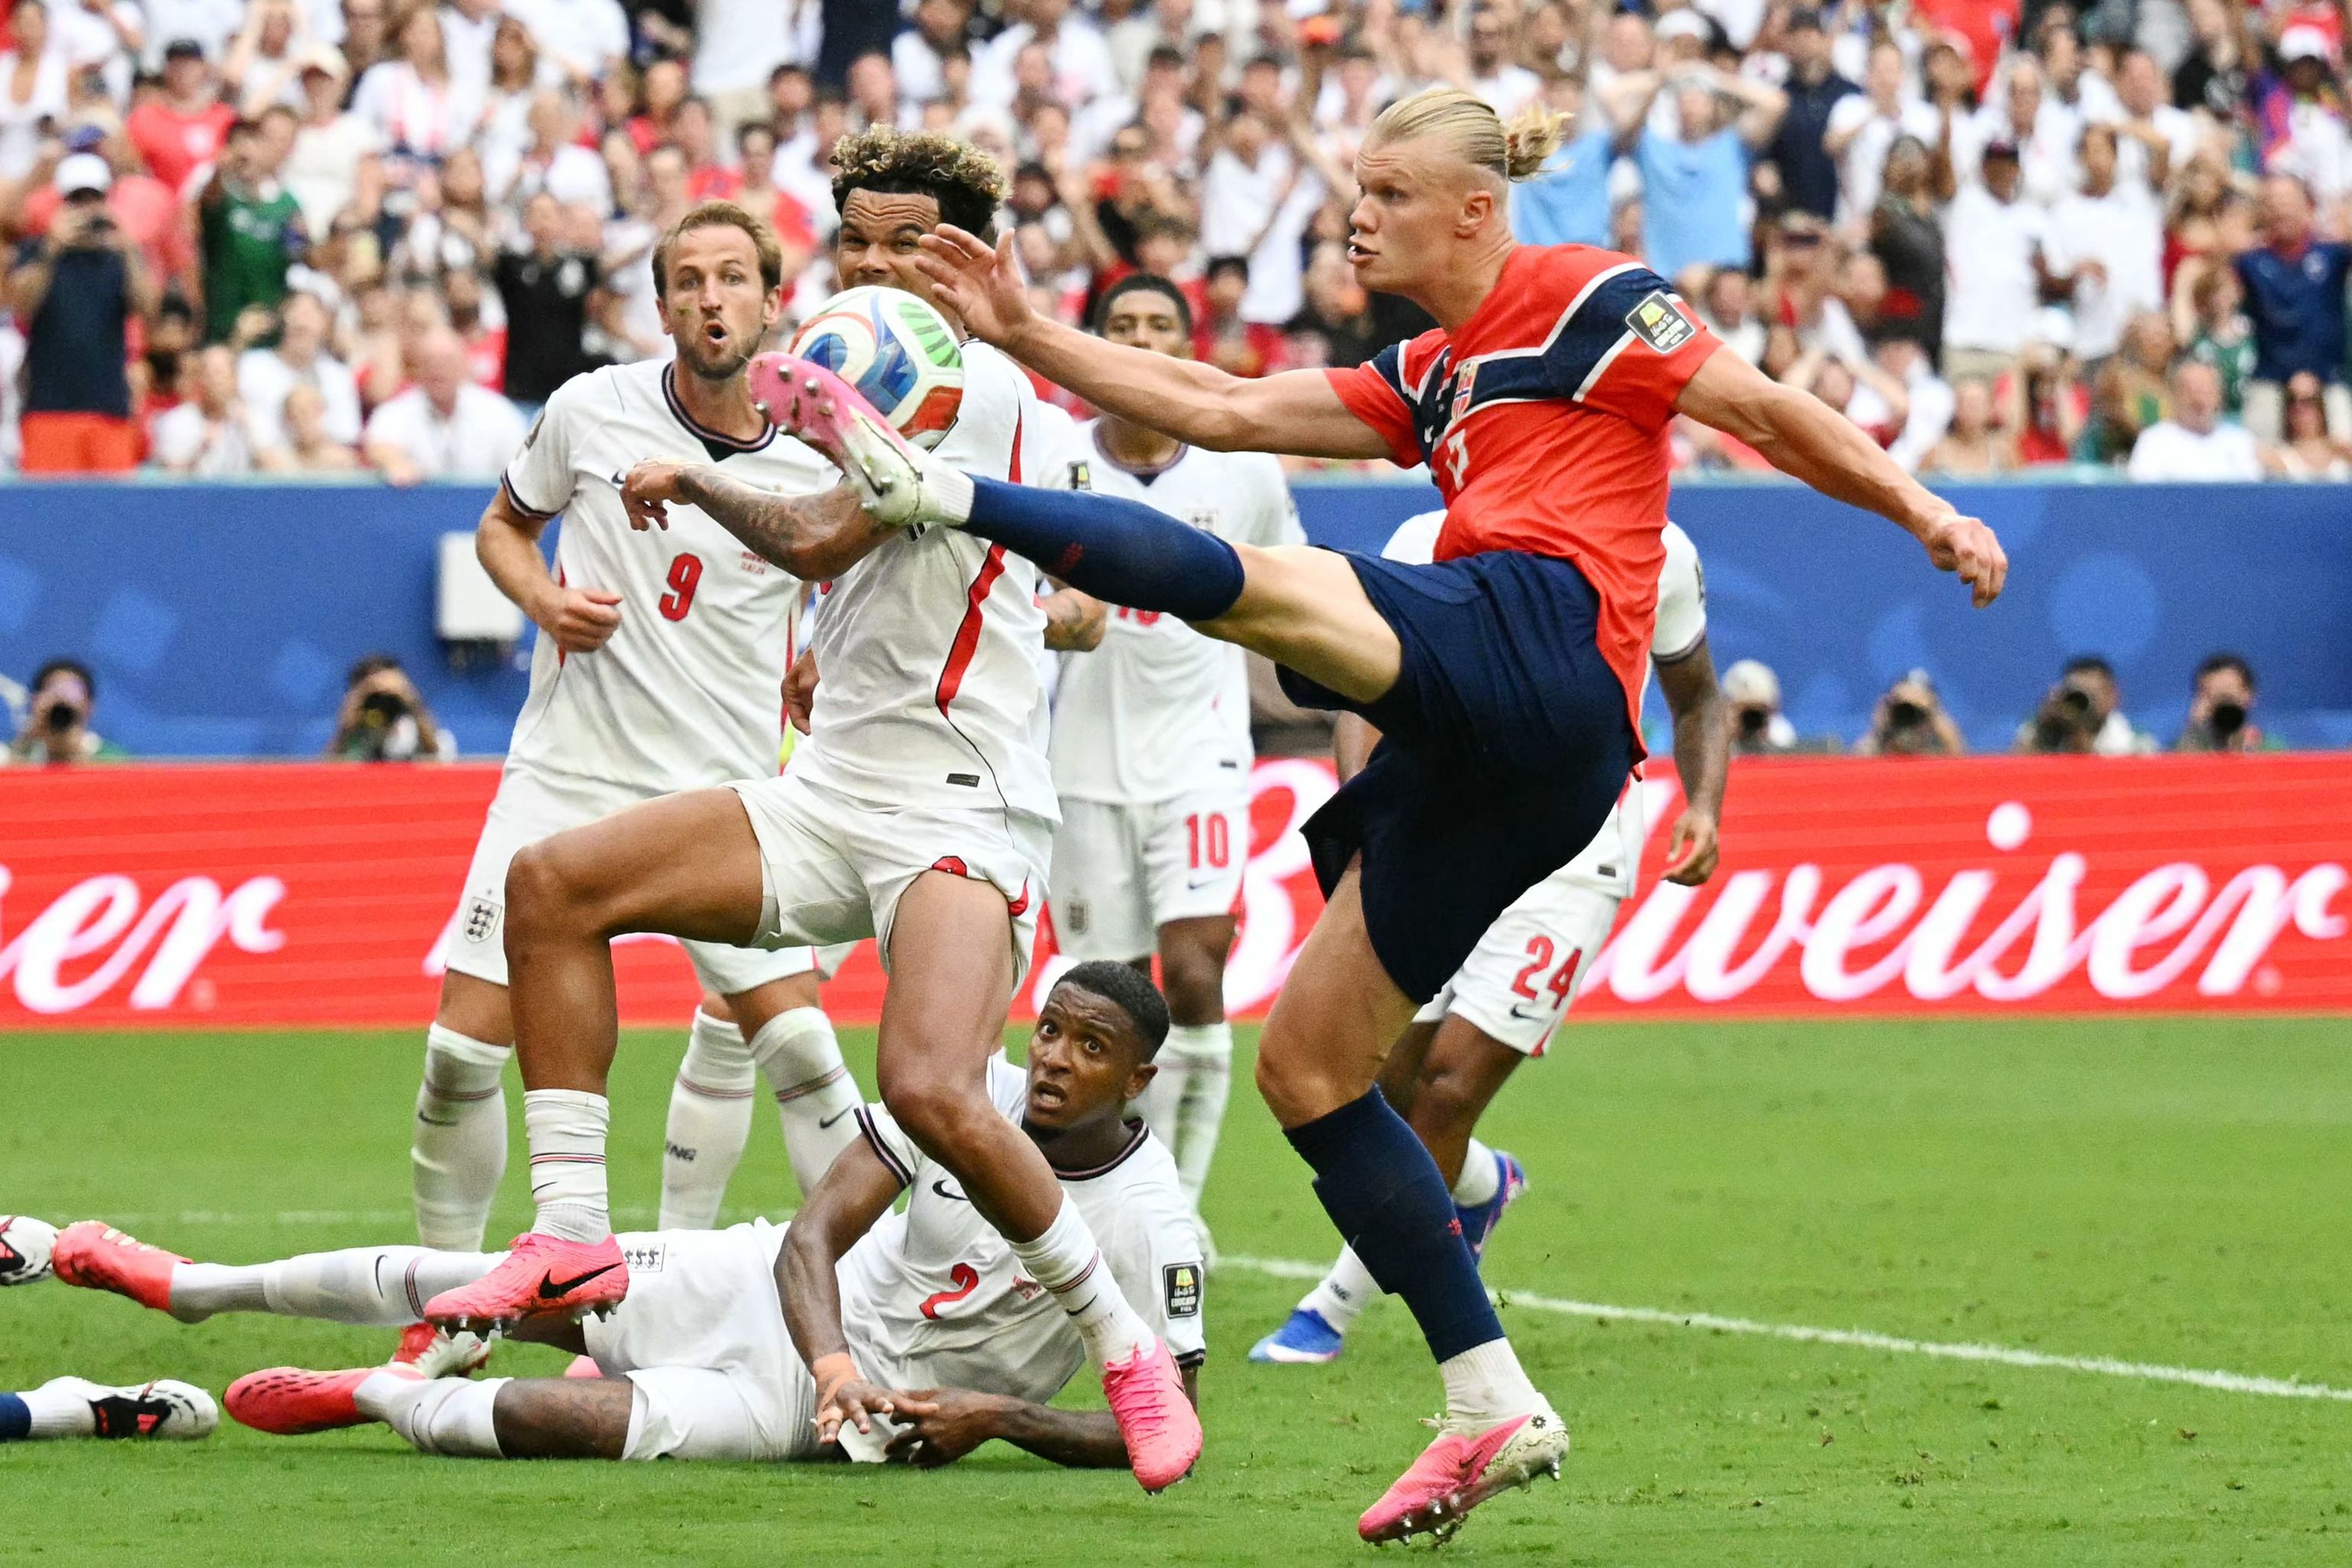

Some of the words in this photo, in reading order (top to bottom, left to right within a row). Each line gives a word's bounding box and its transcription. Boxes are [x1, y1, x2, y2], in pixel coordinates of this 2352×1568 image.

[658, 553, 703, 622] 9
[1184, 812, 1229, 869] 10
[1034, 756, 2347, 1014] Bweiser
[1511, 935, 1582, 1011] 24
[920, 1262, 979, 1320] 2
